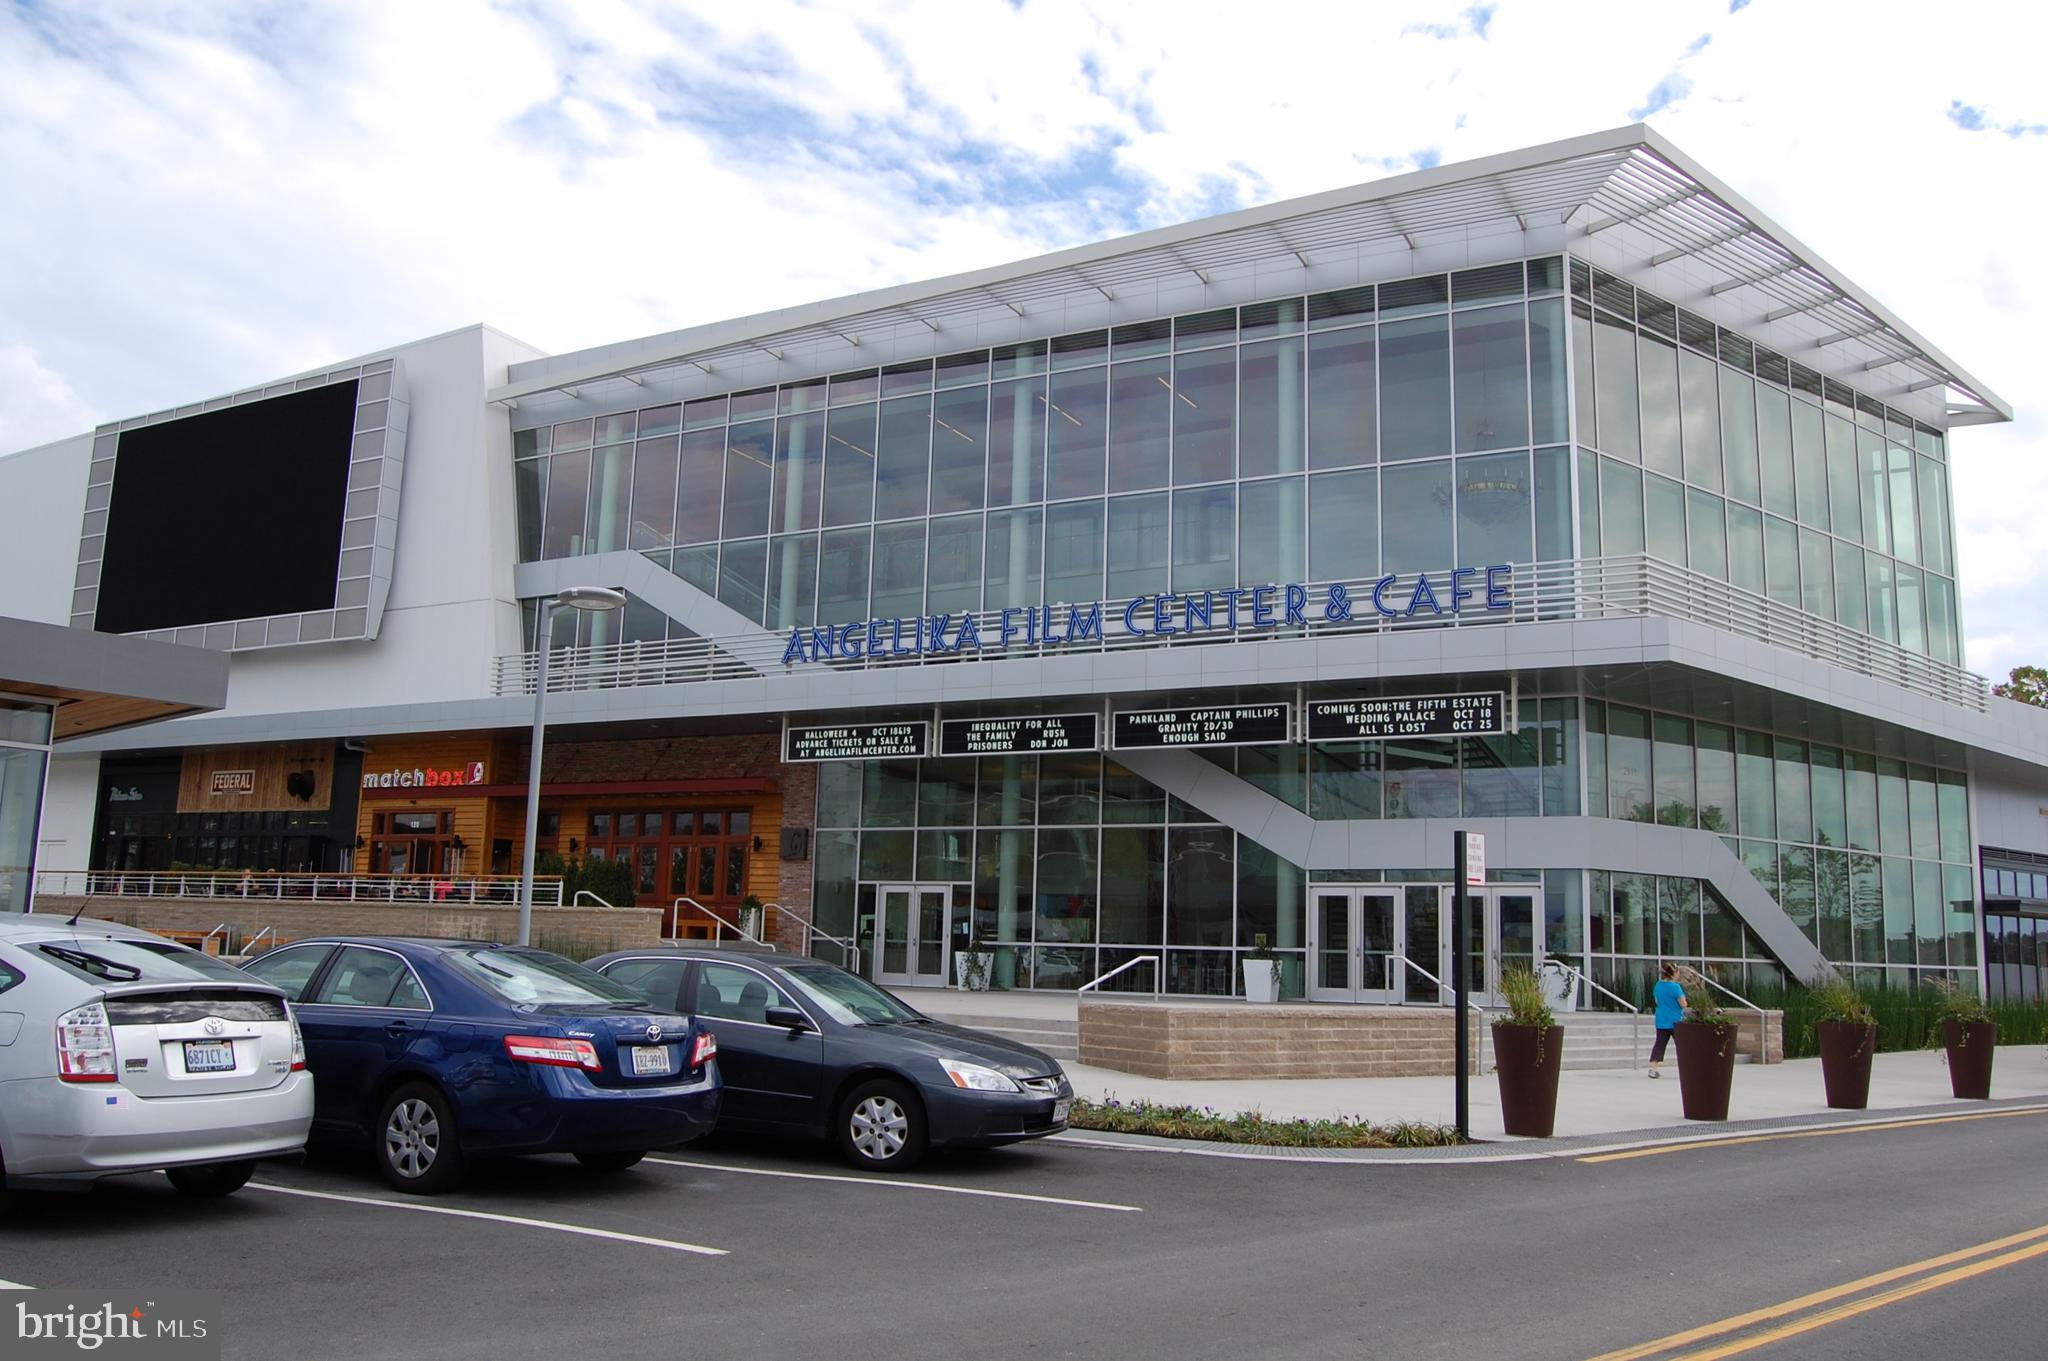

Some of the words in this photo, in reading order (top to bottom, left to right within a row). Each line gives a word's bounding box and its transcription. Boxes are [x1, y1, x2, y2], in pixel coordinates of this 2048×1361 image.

[781, 611, 983, 664] ANGELIKA
[1000, 601, 1103, 647] FILM
[1123, 583, 1308, 637] CENTER
[1324, 583, 1352, 621] &
[1371, 564, 1512, 617] CAFE
[1317, 704, 1356, 715] COMING
[1417, 699, 1447, 709] FIFTH
[1452, 697, 1493, 708] ESTATE
[1129, 713, 1176, 724] PARKLAND
[1190, 711, 1231, 722] CAPTAIN
[1236, 708, 1280, 719] PHILLIPS
[1345, 713, 1390, 724] WEDDING
[1395, 711, 1436, 722] PALACE
[1454, 709, 1474, 719] OCT
[1480, 708, 1492, 718] 18
[971, 721, 1022, 732] INEQUALITY
[1025, 720, 1042, 729] FOR
[1046, 719, 1062, 728] ALL
[1158, 723, 1198, 733] GRAVITY
[1204, 721, 1234, 731] 2D/3D
[1359, 724, 1377, 734] ALL
[1384, 724, 1394, 733] IS
[1400, 722, 1426, 733] LOST
[1452, 720, 1474, 730] OCT
[1479, 719, 1492, 729] 25
[805, 729, 848, 739] HALLOWEEN
[851, 729, 857, 737] 4
[872, 727, 887, 736] OCT
[967, 732, 981, 741] THE
[986, 731, 1017, 740] FAMILY
[1043, 729, 1065, 738] RUSH
[1163, 733, 1199, 743] ENOUGH
[1204, 732, 1226, 741] SAID
[795, 738, 828, 749] ADVANCE
[832, 738, 862, 748] TICKETS
[866, 737, 876, 746] ON
[880, 736, 899, 745] SALE
[903, 735, 914, 744] AT
[967, 741, 1013, 751] PRISONERS
[1030, 739, 1047, 749] DON
[1052, 738, 1068, 748] JON
[800, 749, 809, 758] AT
[815, 745, 917, 757] ANGELIKAFILMCENTER.COM
[214, 773, 251, 789] FEDERAL
[362, 768, 465, 788] matchbox
[187, 1048, 222, 1065] 6871CY
